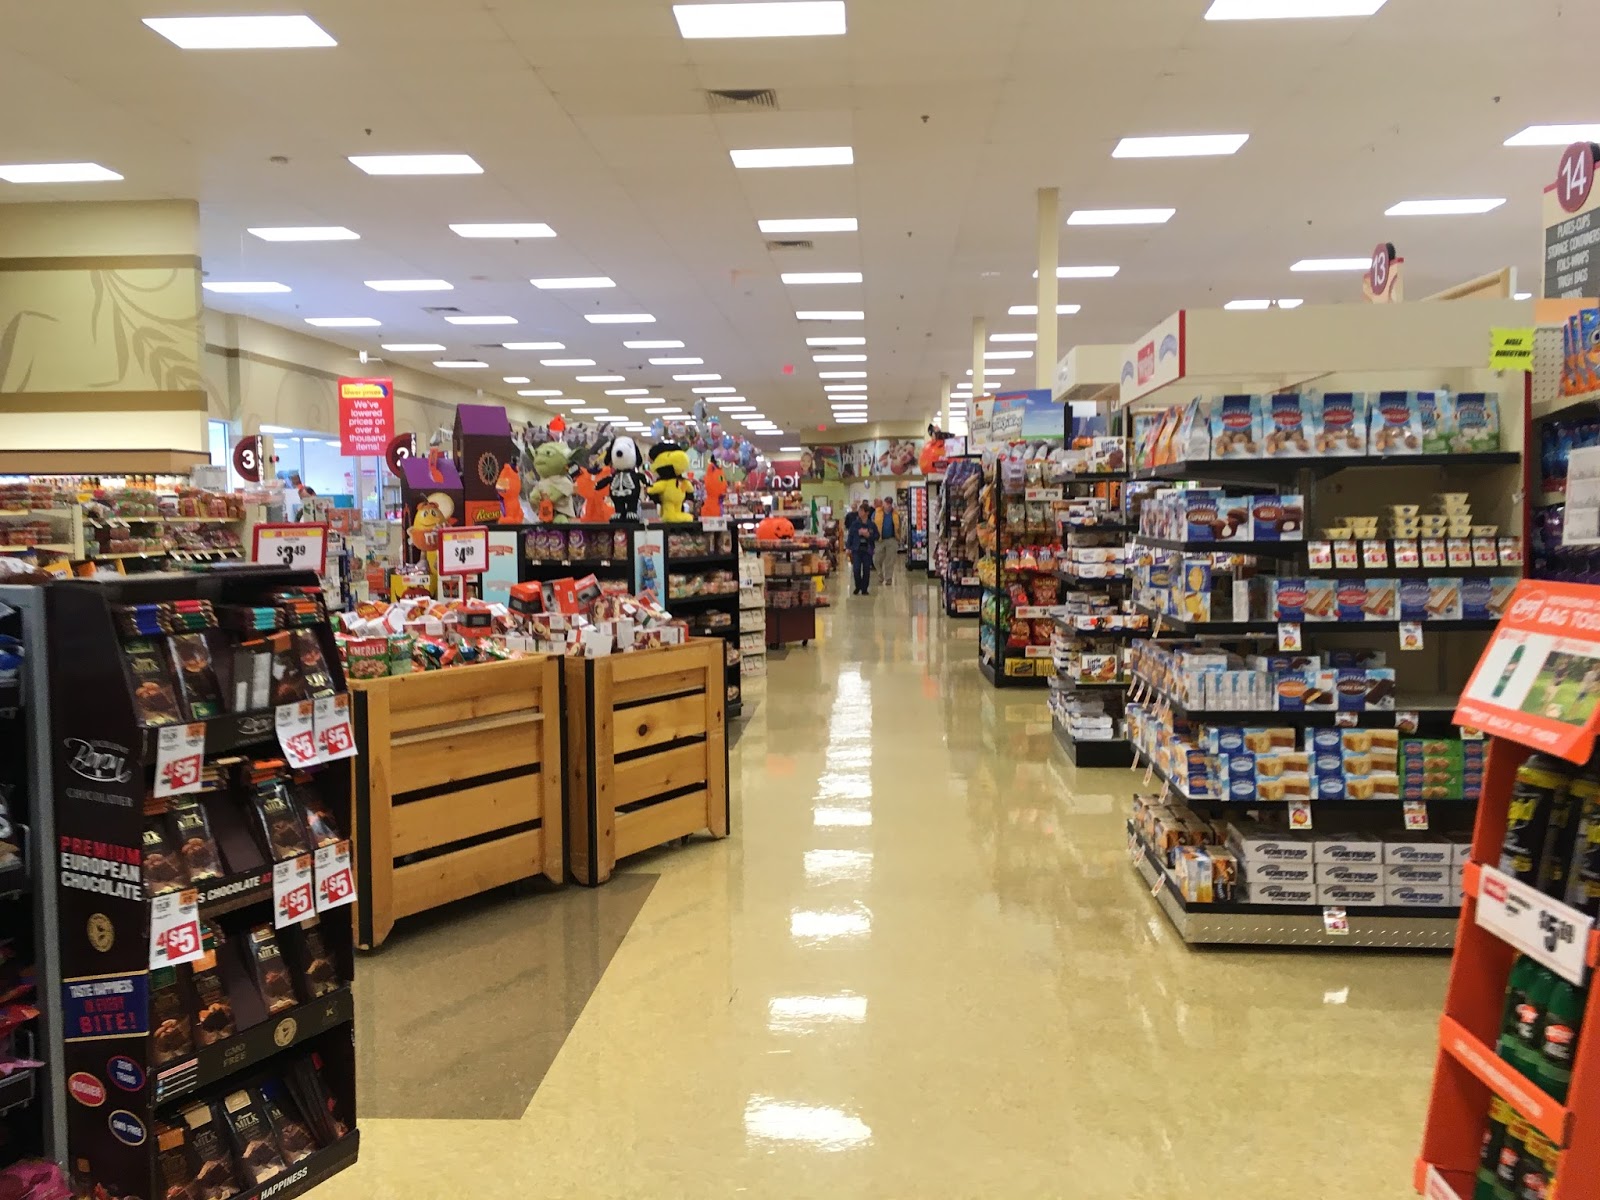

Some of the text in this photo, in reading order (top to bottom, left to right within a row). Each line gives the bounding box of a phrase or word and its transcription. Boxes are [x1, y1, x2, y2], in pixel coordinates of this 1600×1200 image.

[1562, 151, 1587, 200] 14
[1373, 252, 1386, 286] 13
[1574, 268, 1589, 285] BAGS
[1495, 349, 1531, 357] DIRECTORY
[351, 409, 382, 417] lowered
[354, 400, 379, 409] We've
[349, 418, 373, 427] prices
[349, 434, 386, 442] thousand
[355, 443, 380, 451] items!
[242, 449, 255, 469] 3
[1538, 607, 1570, 626] BAG
[60, 836, 141, 866] PREMIUM
[61, 852, 141, 883] EUROPEAN
[61, 871, 142, 902] CHOCOLATE
[207, 877, 260, 901] CHOCOLATE
[168, 926, 194, 953] $5
[80, 1011, 137, 1034] BITE!
[223, 1052, 247, 1067] FREE
[235, 1113, 260, 1130] MILK
[261, 1166, 308, 1200] HAPPINESS
